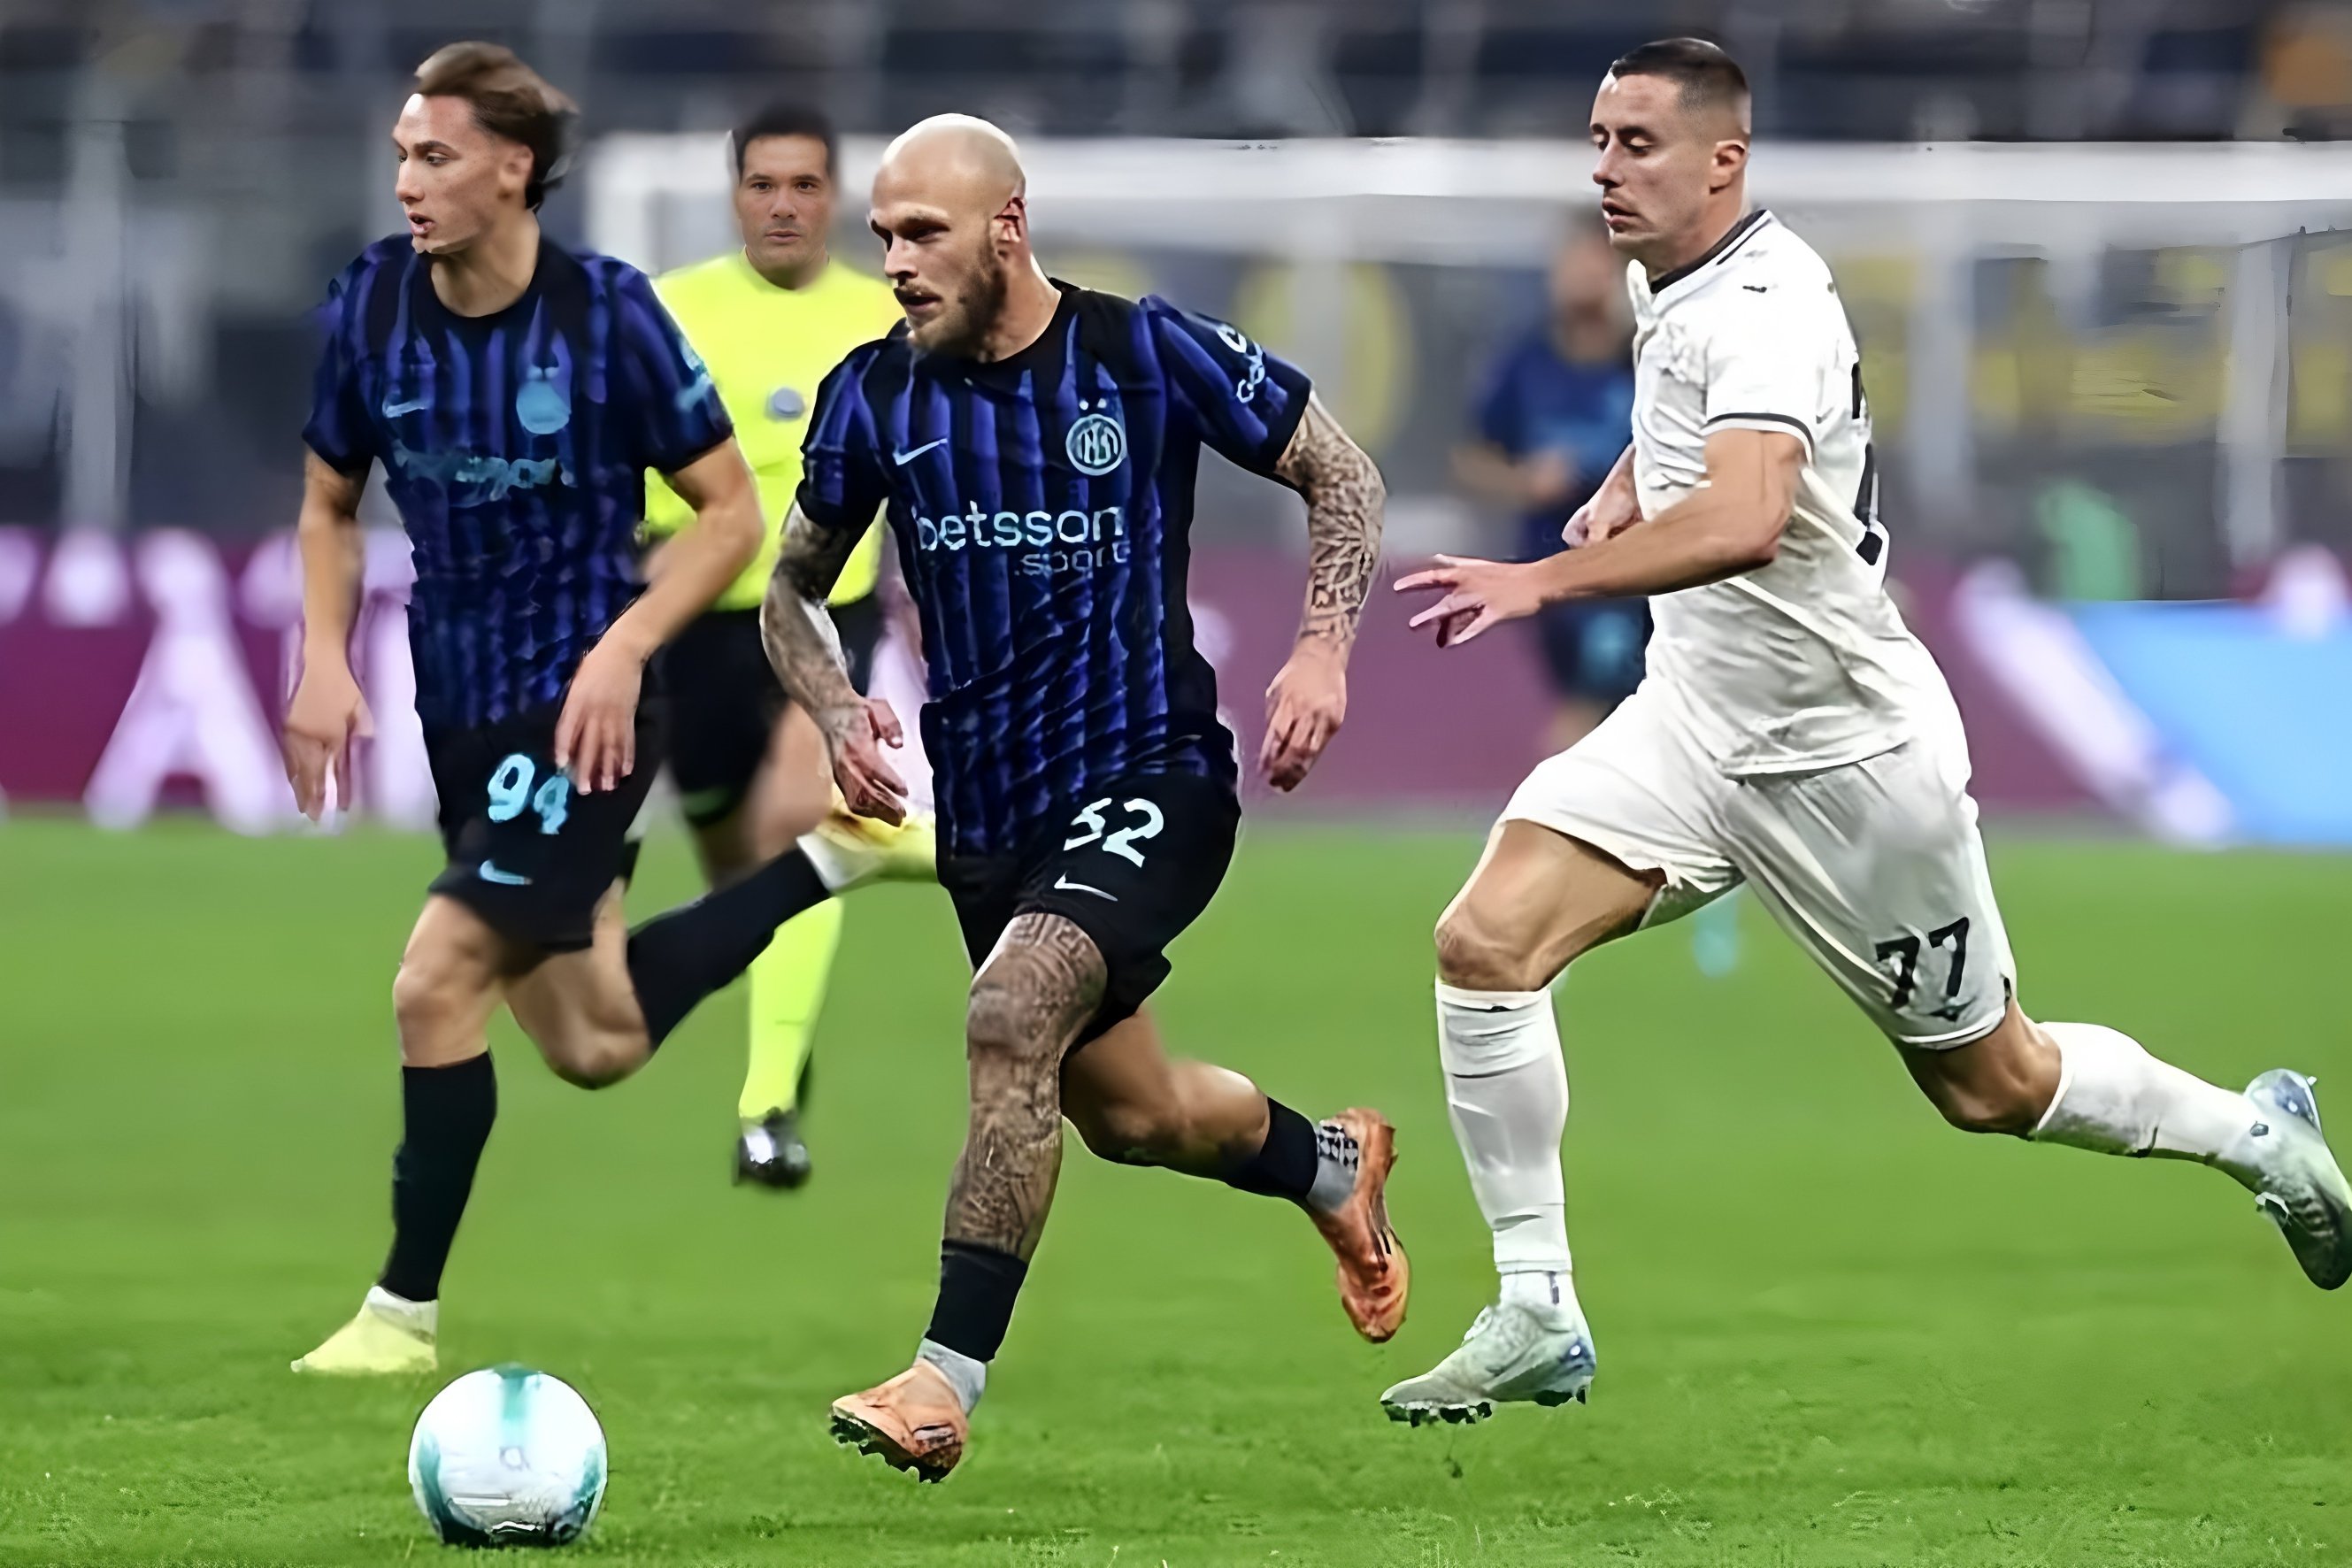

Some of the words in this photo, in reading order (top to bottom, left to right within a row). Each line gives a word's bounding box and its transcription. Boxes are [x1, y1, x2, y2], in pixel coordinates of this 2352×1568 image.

[911, 500, 1125, 550] betsson
[488, 753, 570, 834] 94
[1874, 916, 1970, 1008] 77
